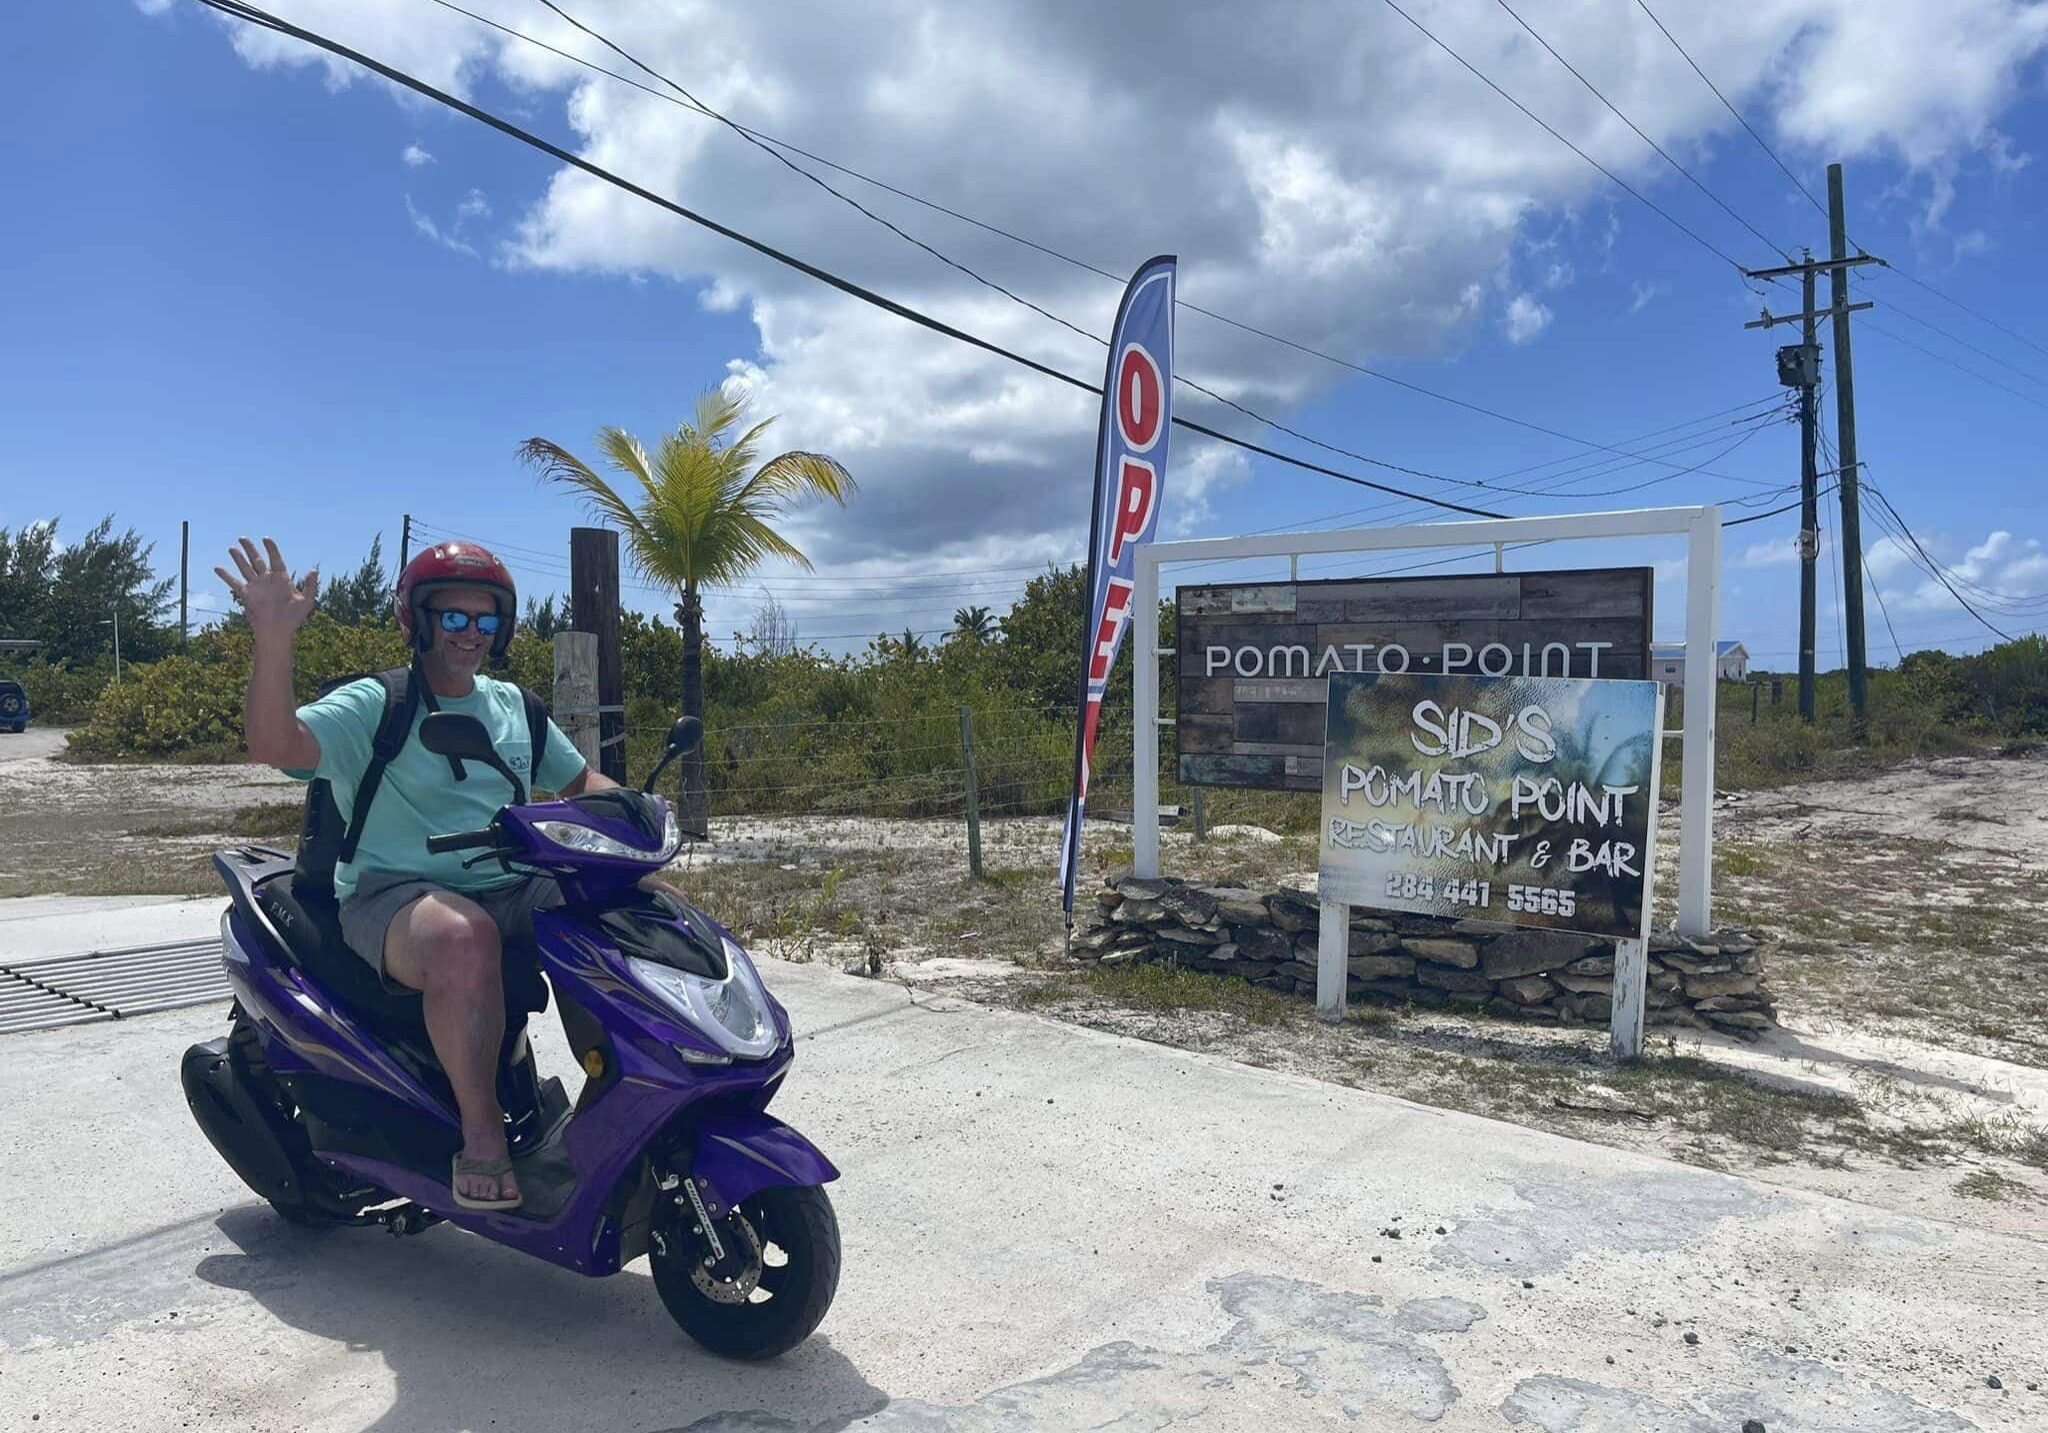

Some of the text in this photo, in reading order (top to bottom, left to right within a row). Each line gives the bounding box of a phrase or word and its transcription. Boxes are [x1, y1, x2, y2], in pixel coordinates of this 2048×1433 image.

[1206, 642, 1613, 677] POMATO POINT
[1411, 700, 1556, 762] SID'S
[1341, 764, 1640, 827] POMATO POINT
[1328, 818, 1641, 878] RESTAURANT & BAR
[1386, 872, 1576, 917] 284 441 5565
